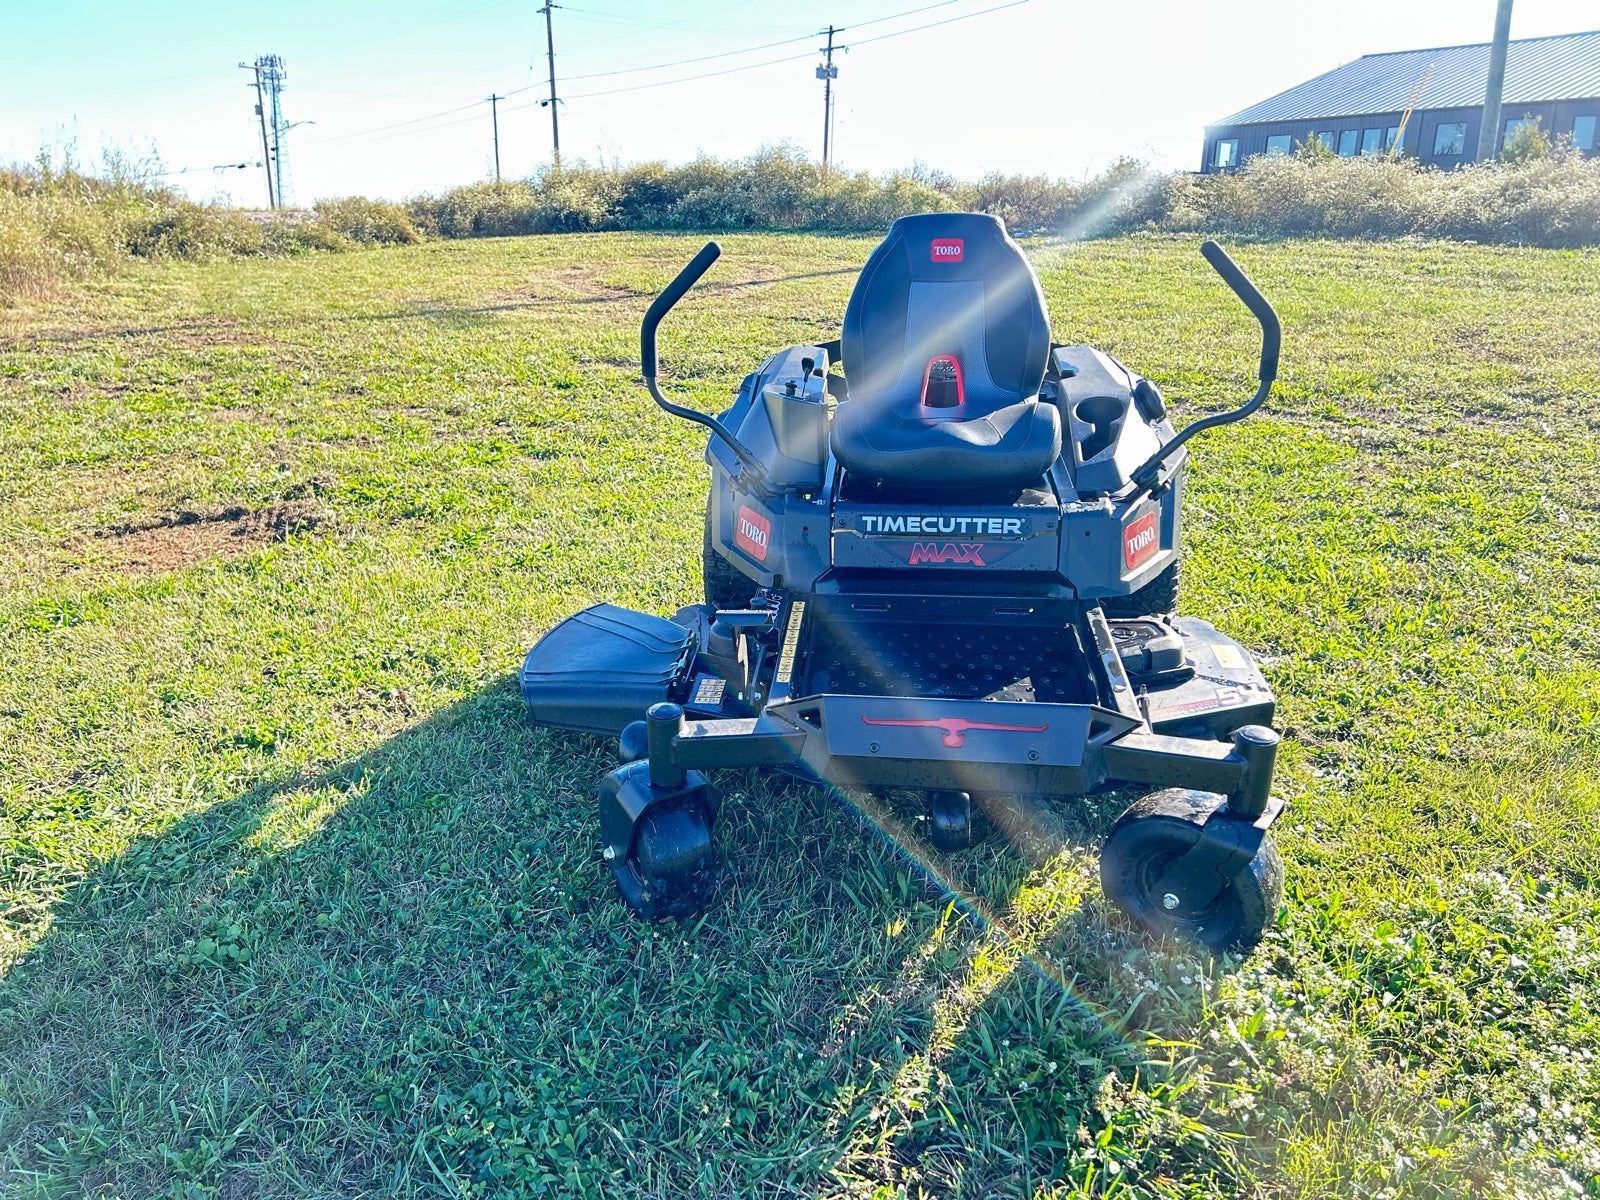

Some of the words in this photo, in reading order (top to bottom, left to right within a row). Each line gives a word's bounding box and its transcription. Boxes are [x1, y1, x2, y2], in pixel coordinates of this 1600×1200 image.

[934, 246, 961, 255] TORO
[740, 517, 767, 547] TORO
[862, 516, 1023, 535] TIMECUTTER
[1127, 526, 1154, 555] TORO
[908, 542, 987, 567] MAX
